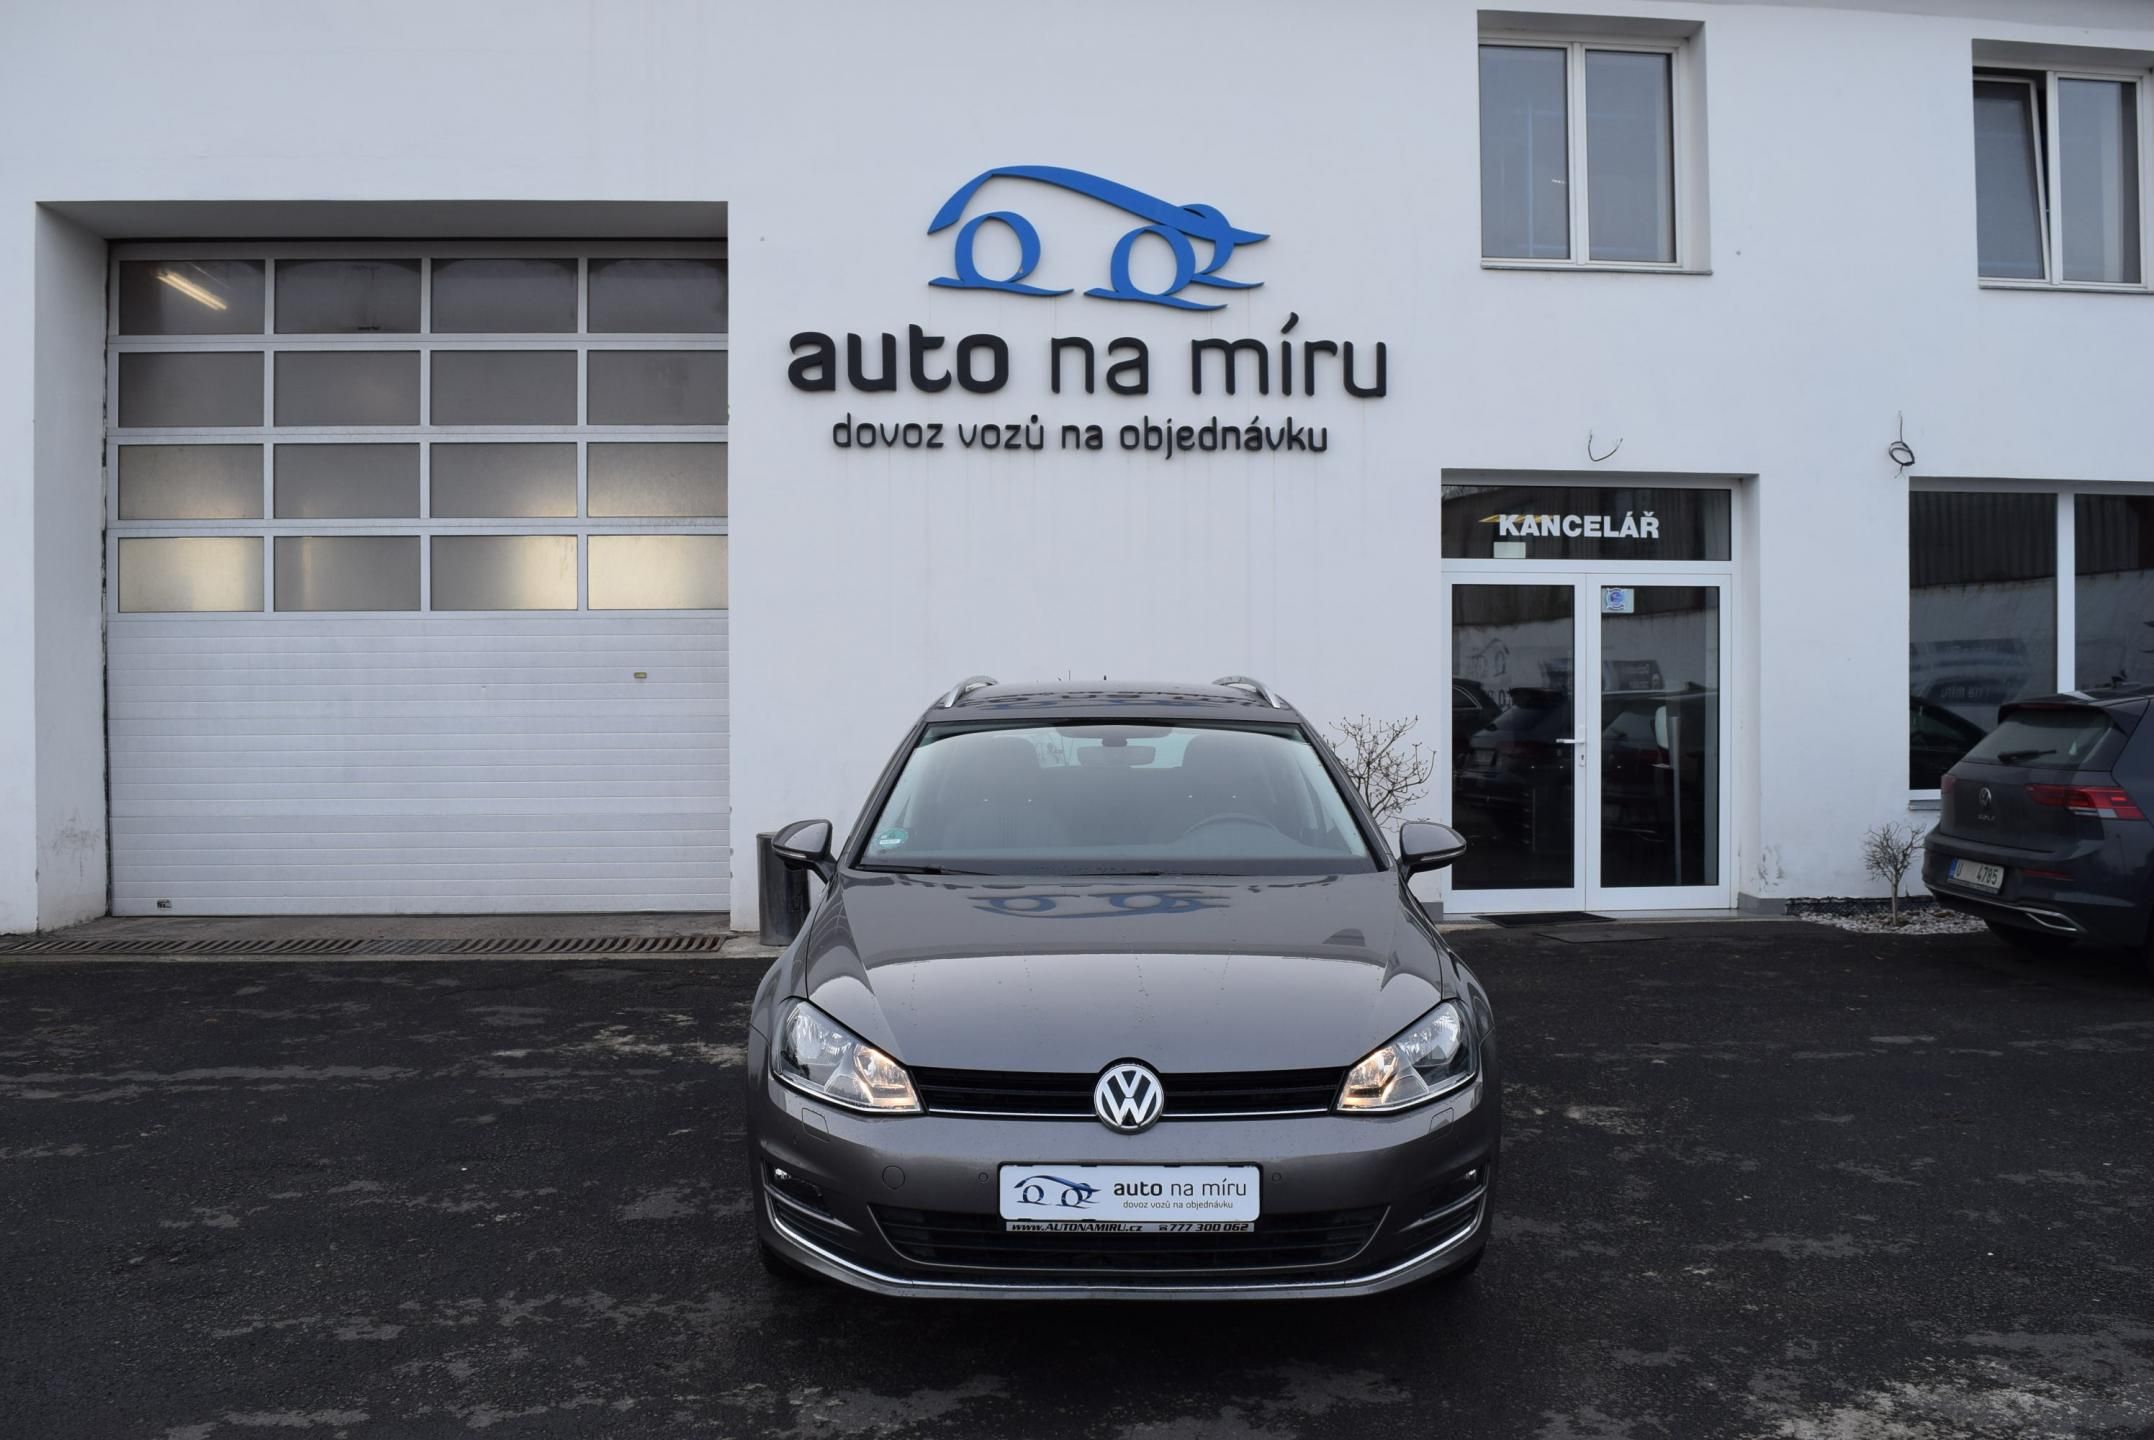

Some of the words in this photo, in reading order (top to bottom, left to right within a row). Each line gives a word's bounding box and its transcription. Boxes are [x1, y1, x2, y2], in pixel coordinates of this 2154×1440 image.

[787, 323, 1010, 394] auto
[1051, 336, 1149, 396] na
[1192, 312, 1388, 398] míru
[832, 412, 945, 450] dovoz
[958, 413, 1045, 451] vozů
[1061, 423, 1104, 452] na
[1119, 415, 1328, 460] objednávku
[1499, 511, 1660, 539] KANCELÁŘ
[1113, 1181, 1163, 1197] auto
[1170, 1182, 1194, 1197] na
[1201, 1177, 1247, 1197] míru
[1123, 1200, 1149, 1209] dovoz
[1173, 1201, 1184, 1209] na
[1185, 1200, 1233, 1210] objednávku
[1196, 1223, 1222, 1232] 300
[1223, 1223, 1249, 1232] 062
